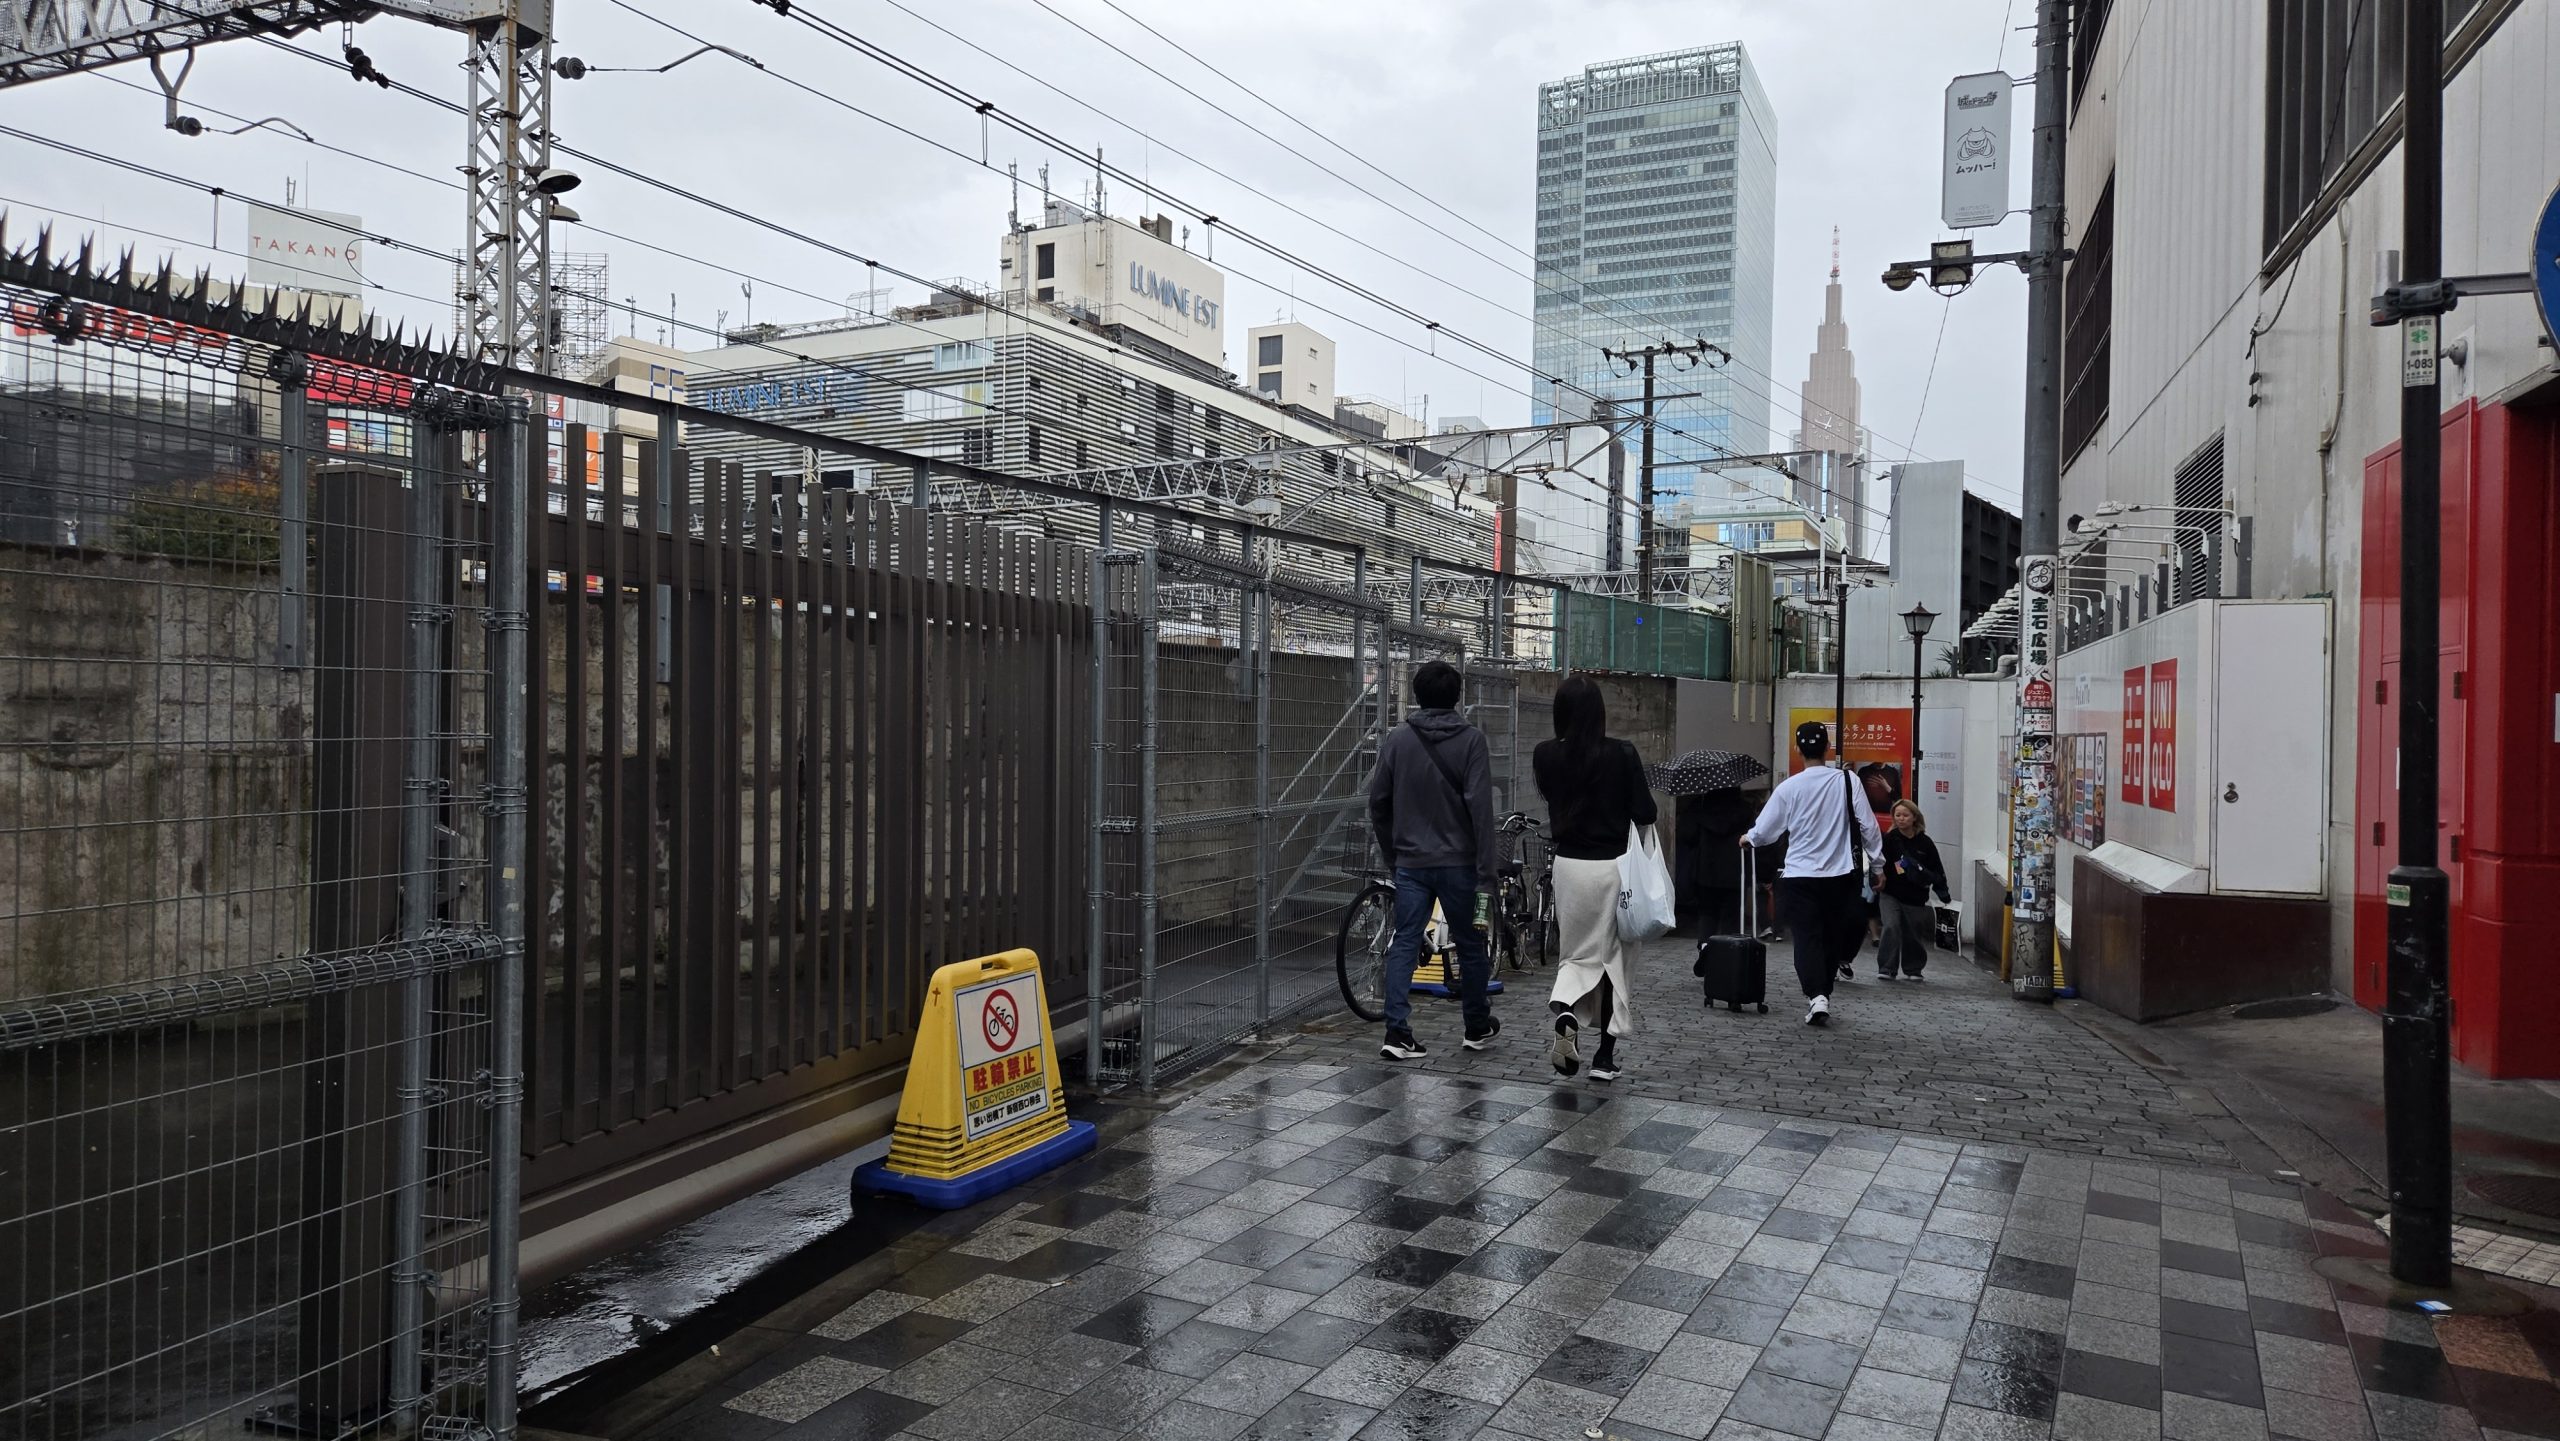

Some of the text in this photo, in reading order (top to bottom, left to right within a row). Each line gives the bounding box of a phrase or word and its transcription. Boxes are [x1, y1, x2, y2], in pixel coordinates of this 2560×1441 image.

[253, 236, 357, 260] TAKANO
[1130, 261, 1219, 330] LUMINE EST
[2406, 359, 2433, 370] 1-083
[2030, 597, 2048, 665] 宝石広場
[2153, 680, 2172, 728] UNI
[2152, 742, 2173, 798] QLO
[973, 1052, 1036, 1092] 駐輪禁止
[969, 1077, 1042, 1111] NO BICYCLES PARKING
[974, 1107, 1005, 1128] 思い出横丁
